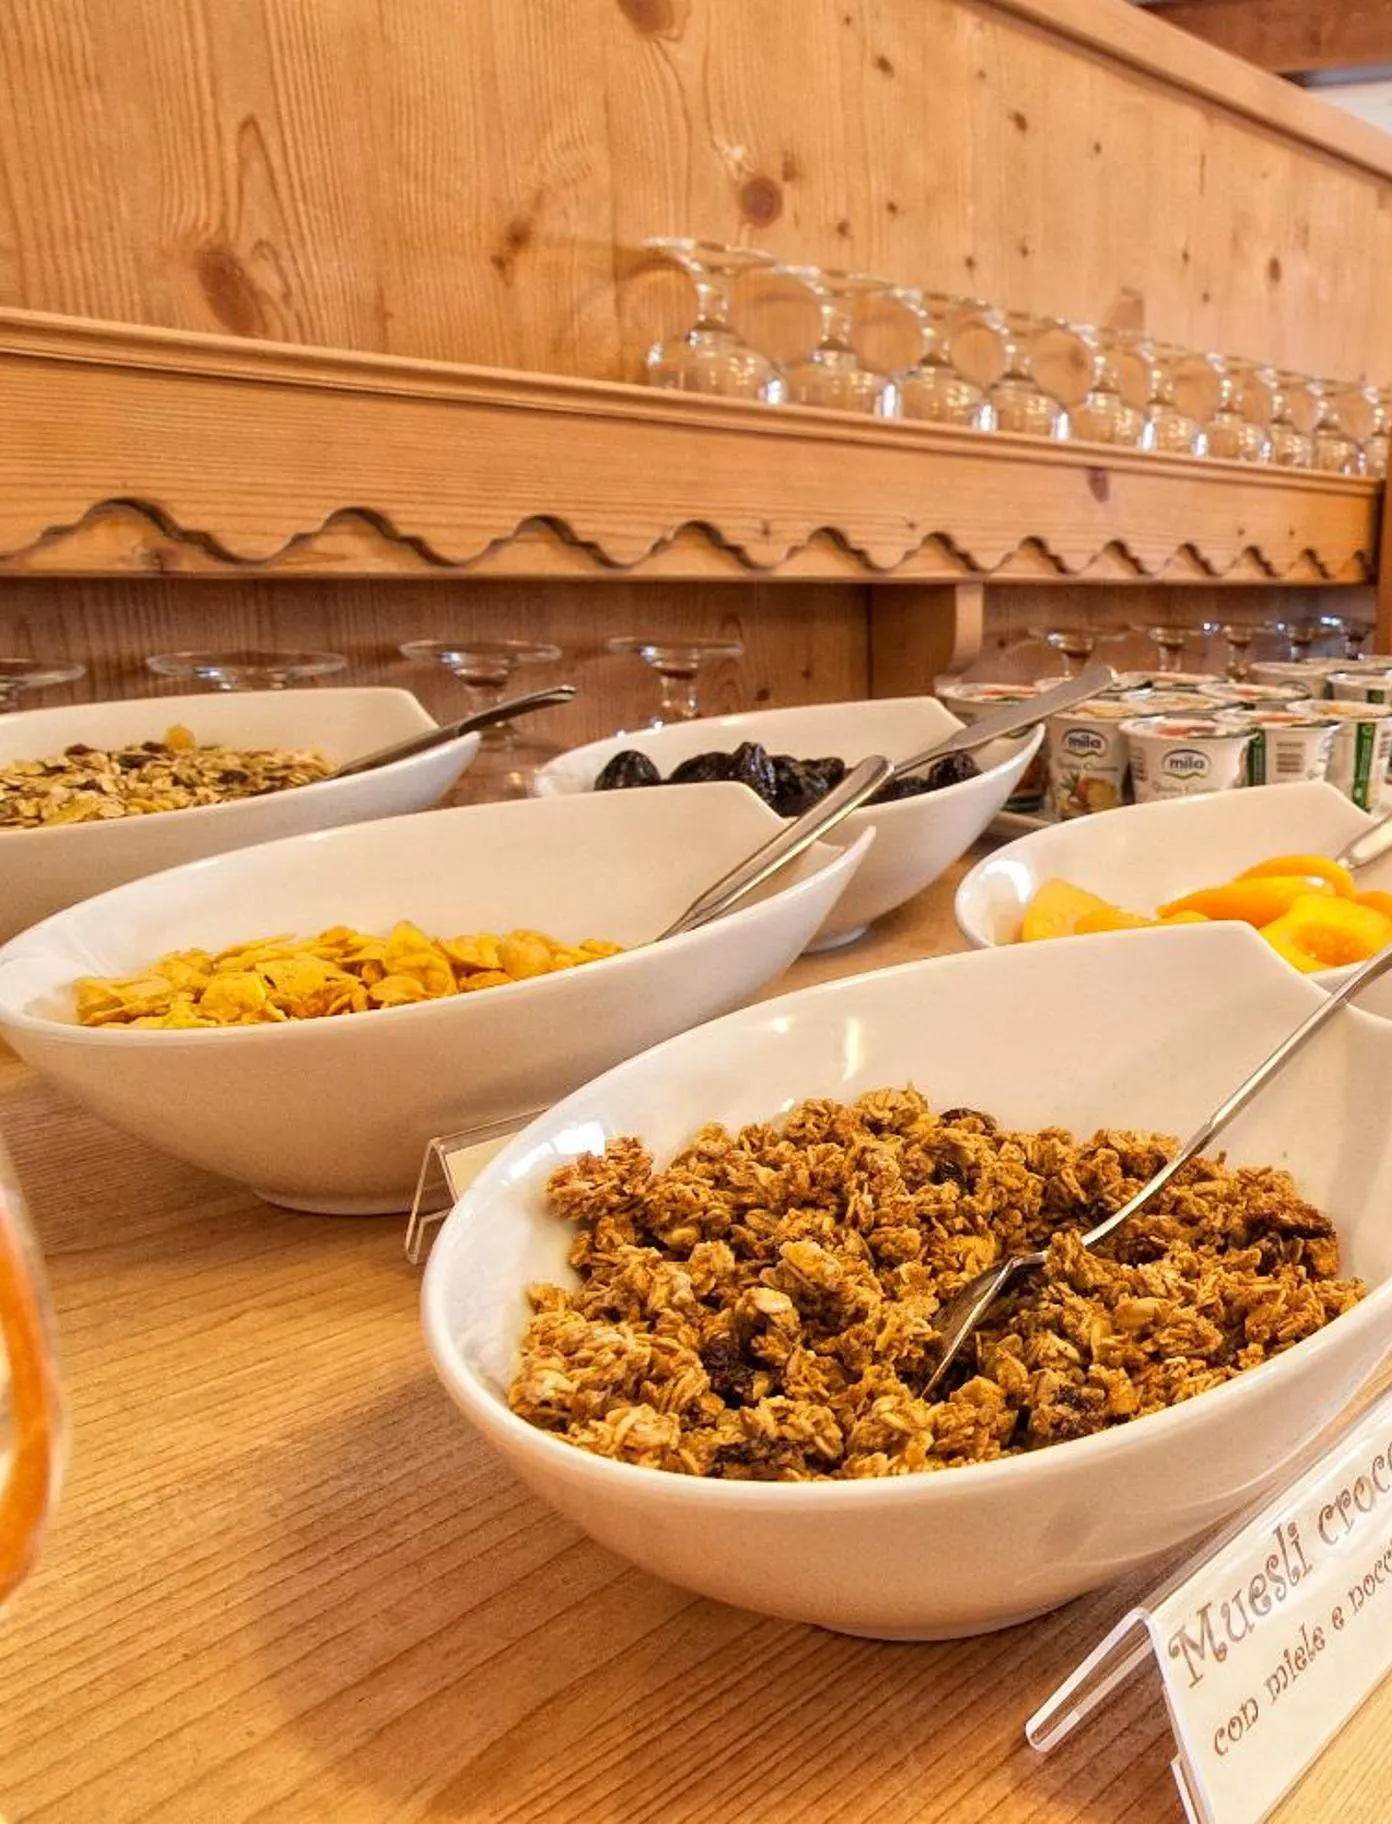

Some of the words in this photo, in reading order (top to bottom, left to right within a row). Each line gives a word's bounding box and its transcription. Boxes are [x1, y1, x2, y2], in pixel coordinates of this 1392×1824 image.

[1169, 755, 1205, 770] mila
[1168, 1519, 1313, 1689] Muesli
[1213, 1697, 1259, 1758] con
[1264, 1622, 1327, 1705] miele
[1331, 1606, 1346, 1631] e
